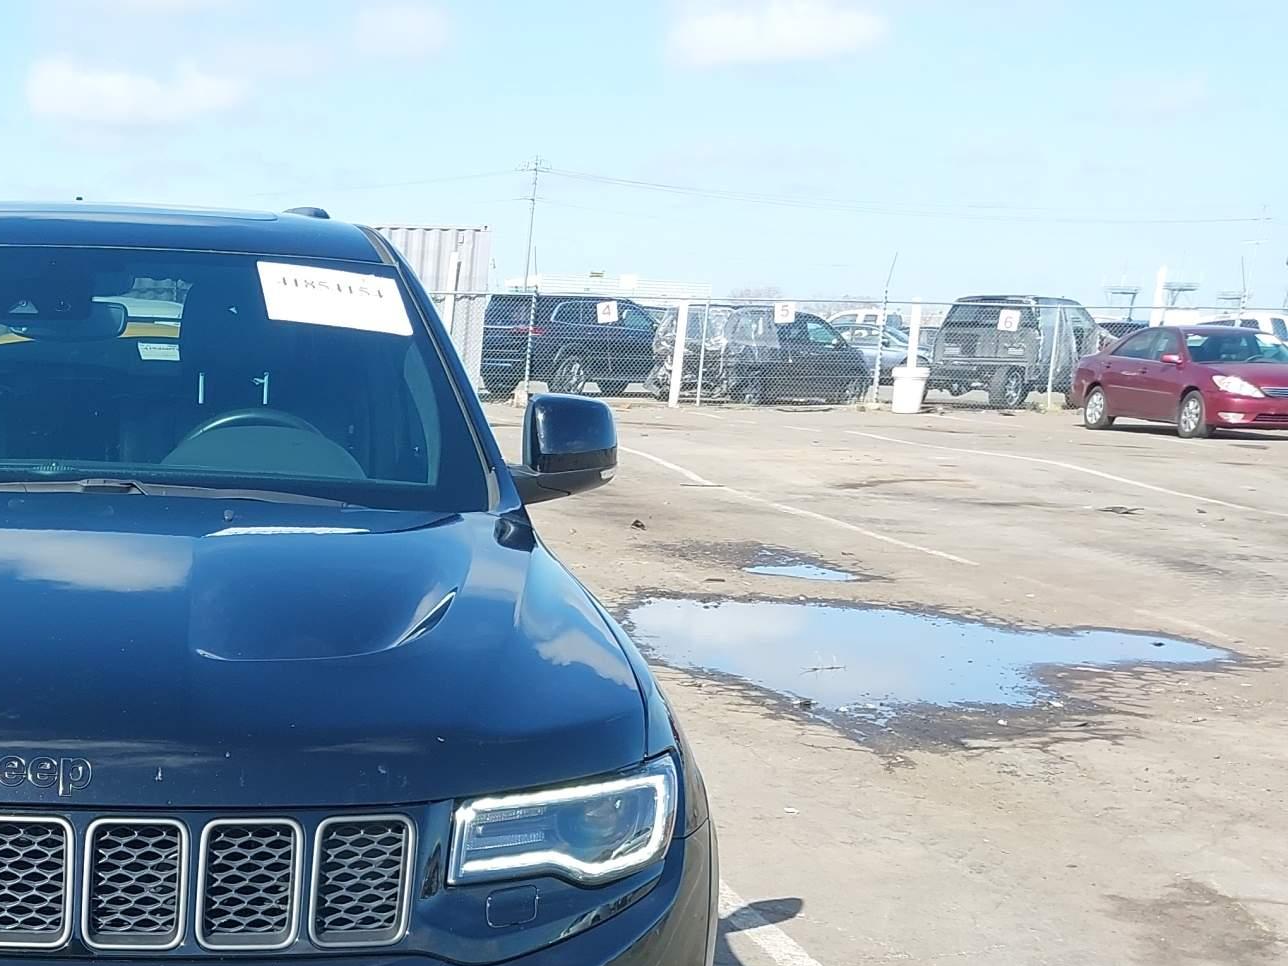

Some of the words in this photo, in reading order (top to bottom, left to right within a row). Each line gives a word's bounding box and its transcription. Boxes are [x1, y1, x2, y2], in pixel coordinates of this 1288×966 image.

[601, 303, 612, 318] 4
[779, 304, 790, 318] 5
[1003, 315, 1014, 329] 6
